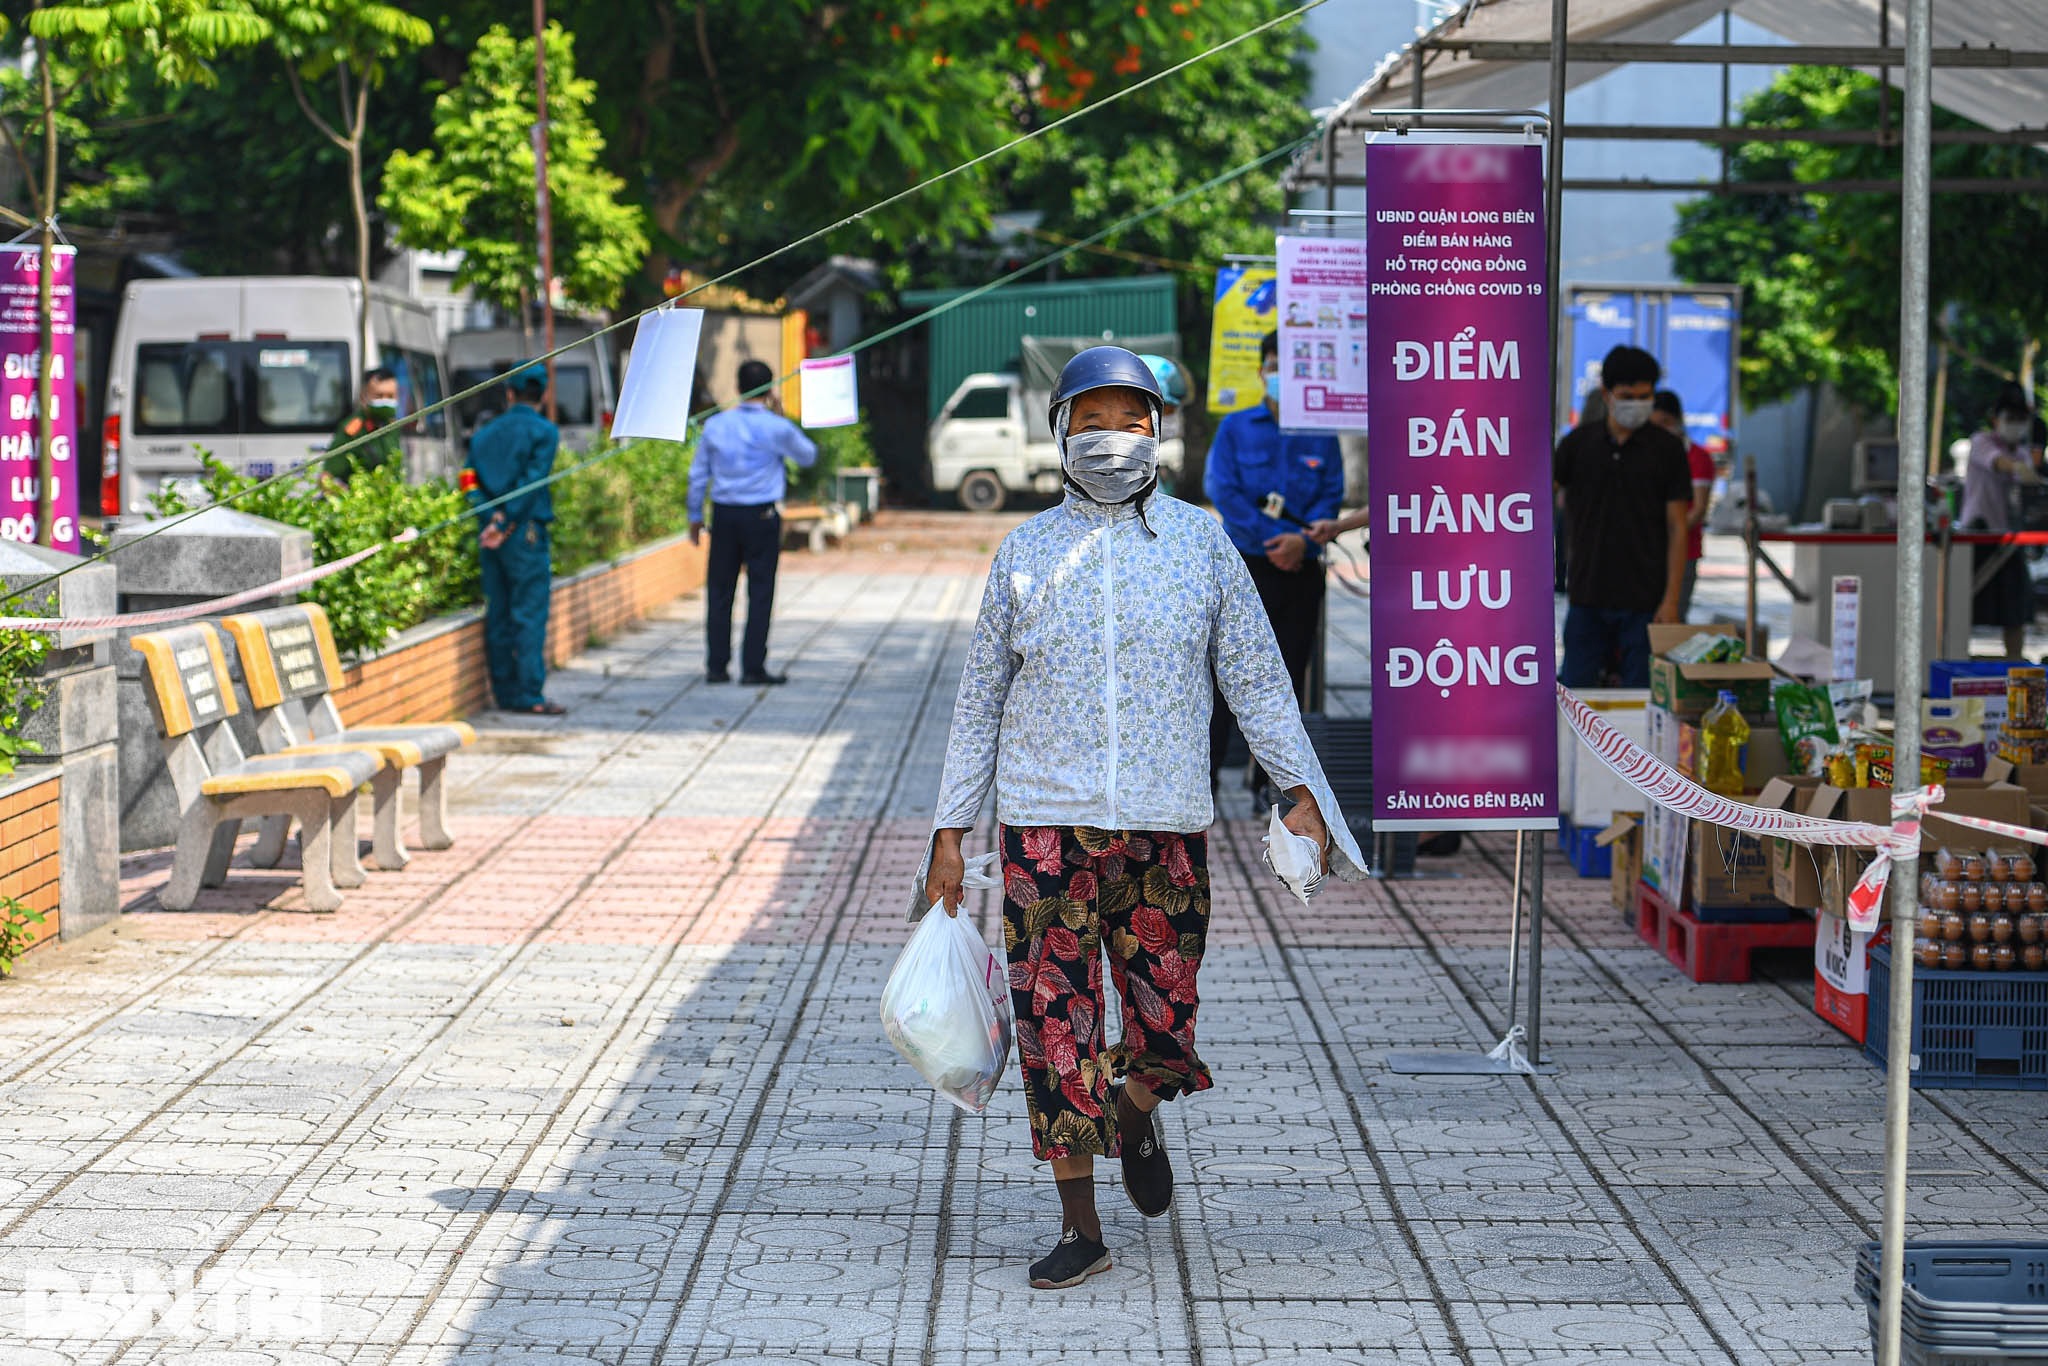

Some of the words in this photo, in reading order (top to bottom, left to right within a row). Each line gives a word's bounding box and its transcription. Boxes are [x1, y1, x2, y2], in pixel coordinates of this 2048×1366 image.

[1376, 210, 1415, 223] UBND
[1418, 208, 1457, 226] QUẬN
[1461, 210, 1499, 224] LONG
[1503, 208, 1535, 224] BIÊN
[1402, 230, 1438, 248] ĐIỂM
[1441, 232, 1469, 248] BÁN
[1472, 232, 1512, 248] HÀNG
[1385, 254, 1407, 272] HỖ
[1410, 257, 1438, 275] TRỢ
[1441, 256, 1482, 276] CỘNG
[1485, 254, 1527, 272] ĐỒNG
[1371, 280, 1420, 296] PHÒNG
[1424, 278, 1476, 296] CHỐNG
[1479, 283, 1522, 296] COVID
[1525, 283, 1542, 296] 19
[1392, 326, 1521, 381] ĐIỂM
[1408, 408, 1510, 457] BÁN
[1388, 485, 1534, 534] HÀNG
[1411, 563, 1512, 611] LƯU
[1385, 638, 1540, 699] ĐỘNG
[1386, 790, 1421, 810] SẴN
[1424, 792, 1469, 809] LÒNG
[1473, 792, 1506, 808] BÊN
[1510, 793, 1544, 811] BẠN
